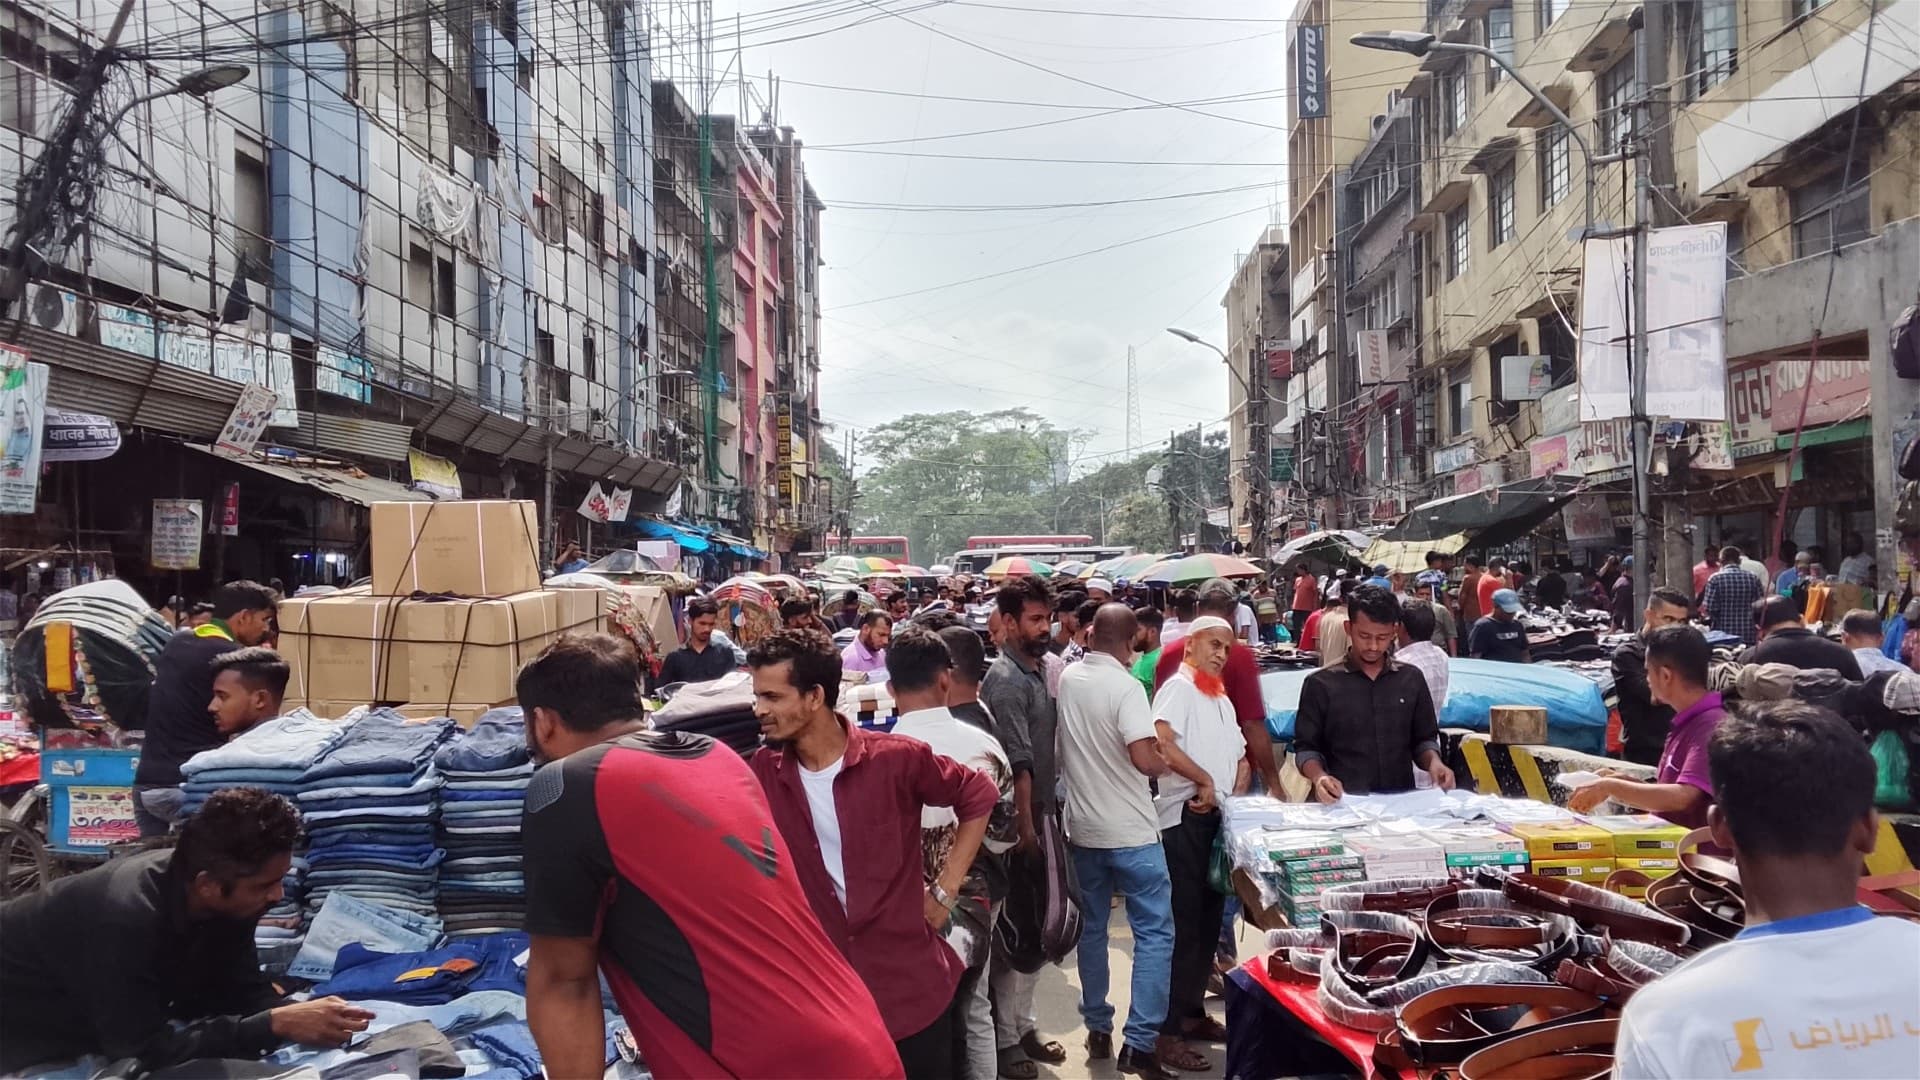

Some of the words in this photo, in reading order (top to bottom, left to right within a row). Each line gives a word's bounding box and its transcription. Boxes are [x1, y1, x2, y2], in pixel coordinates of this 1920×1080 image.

[1305, 27, 1317, 93] LOTTO
[1368, 333, 1381, 379] Bata
[49, 428, 85, 441] ধানের
[1731, 442, 1773, 458] RANT.
[72, 816, 137, 828] ৩৫০০
[1788, 1012, 1895, 1051] الرياض
